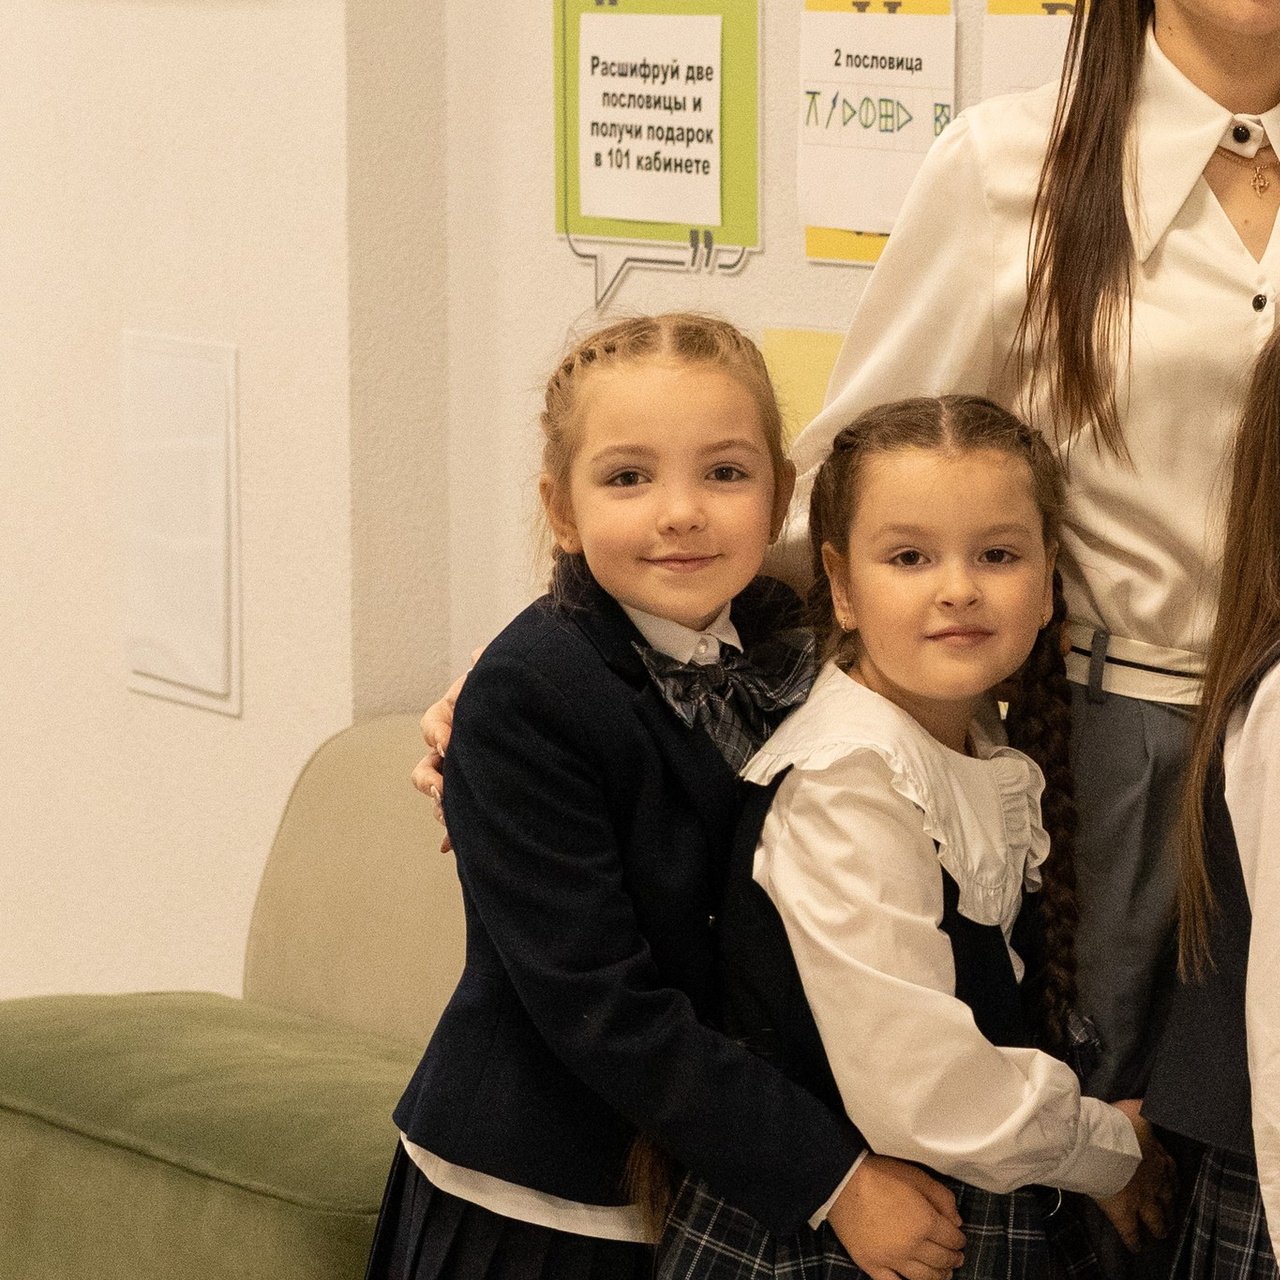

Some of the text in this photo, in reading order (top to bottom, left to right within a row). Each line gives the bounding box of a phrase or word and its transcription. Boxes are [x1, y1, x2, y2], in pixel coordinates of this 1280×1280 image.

[591, 55, 714, 85] Расшифруй две
[834, 48, 923, 74] 2 пословица
[602, 92, 702, 114] пословицы и
[591, 121, 713, 148] получи подарок
[594, 148, 710, 175] в 101 кабинете
